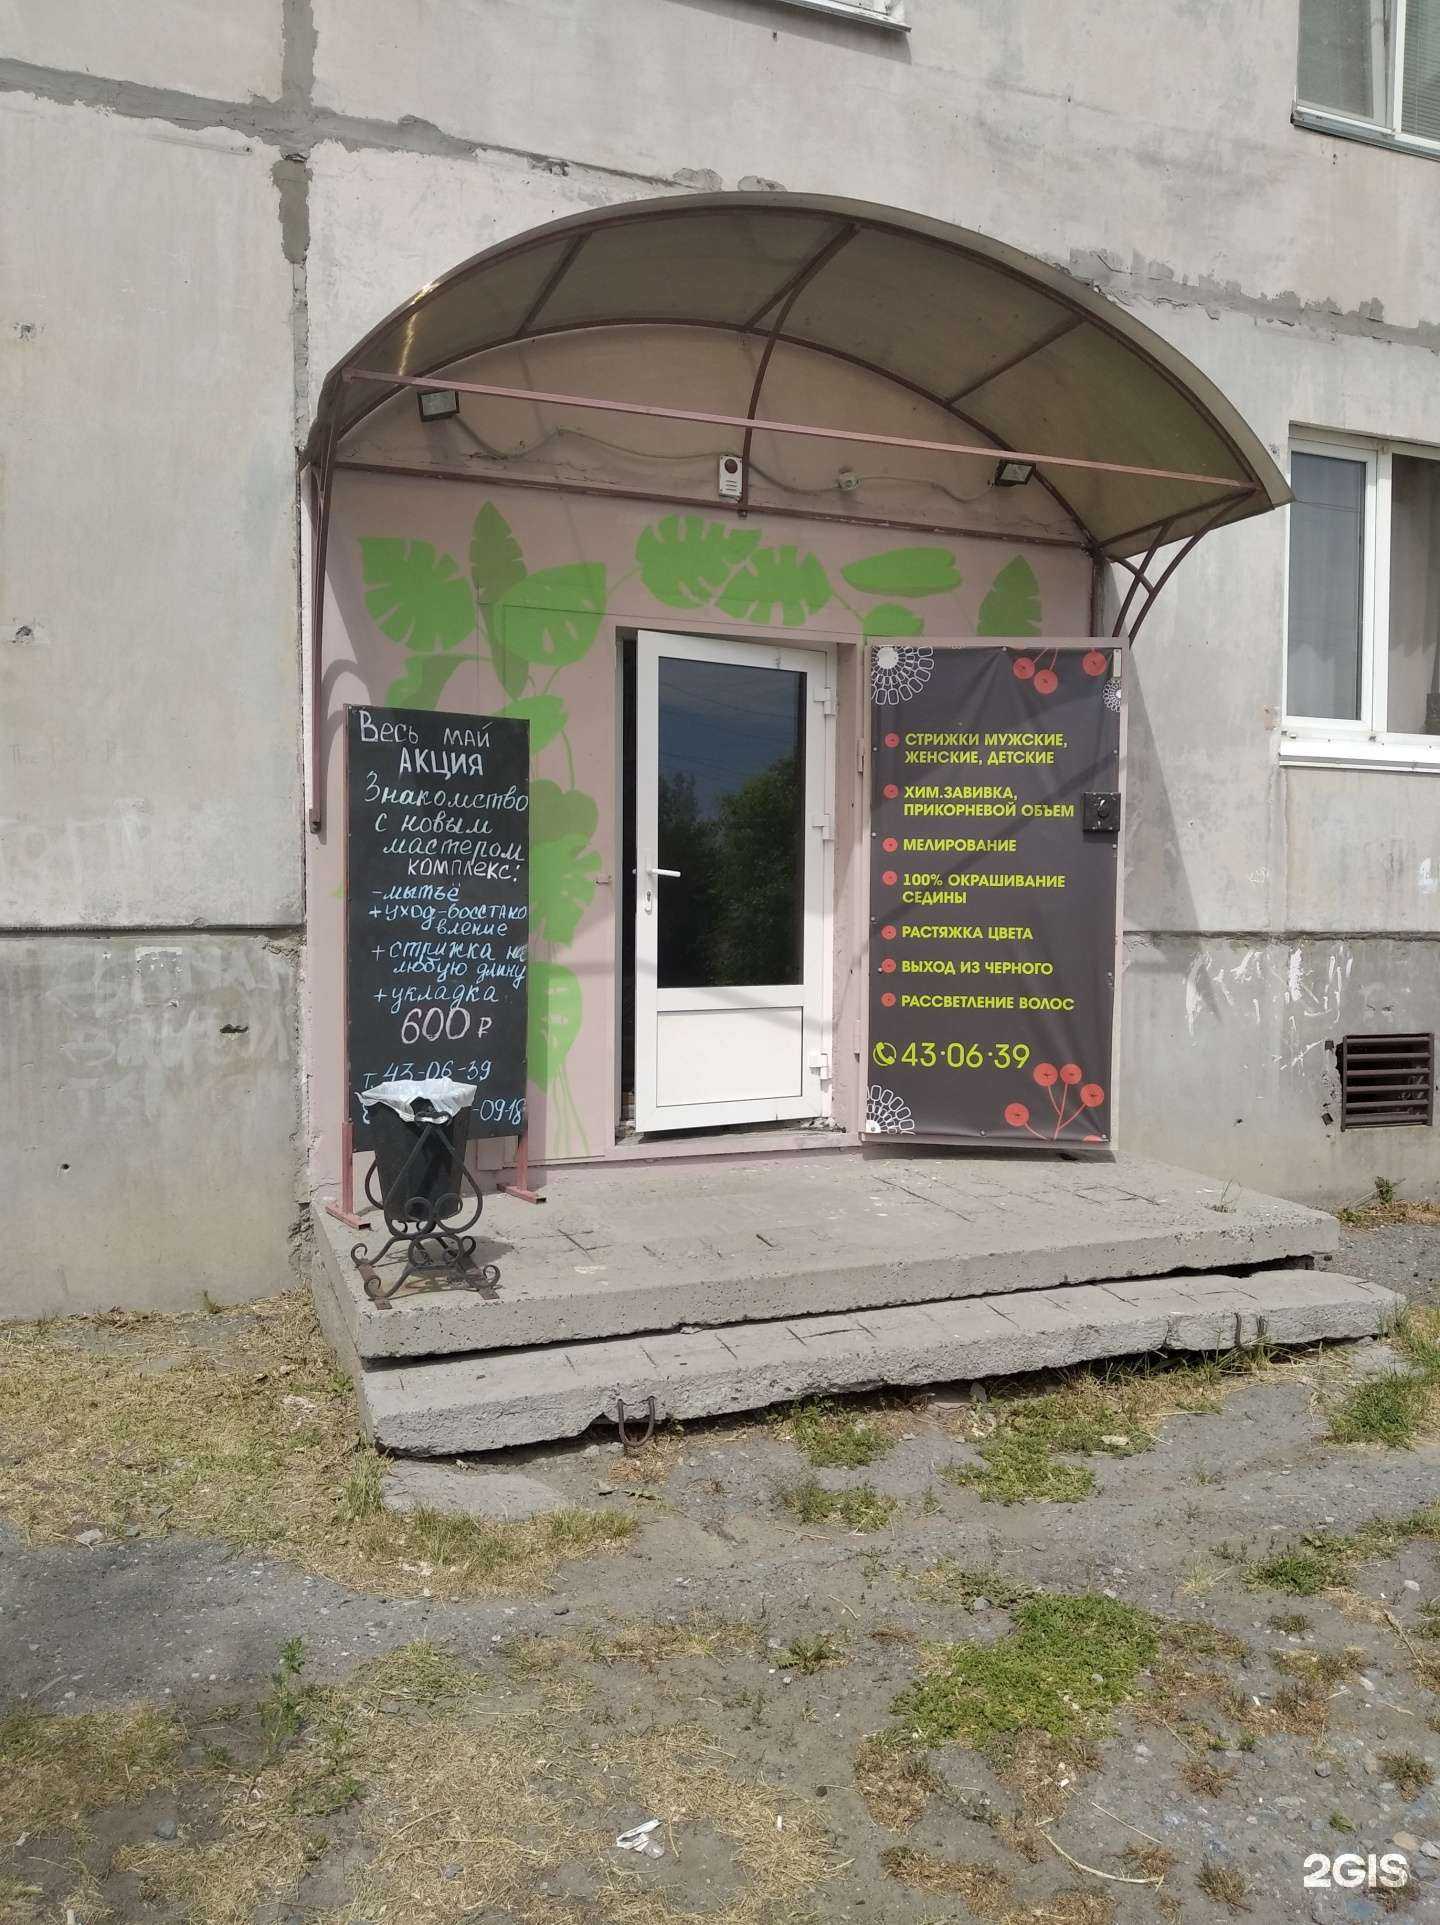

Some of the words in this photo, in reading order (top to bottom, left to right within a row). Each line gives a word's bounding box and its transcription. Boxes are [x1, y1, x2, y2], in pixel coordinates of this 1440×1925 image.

[359, 710, 419, 744] Весь
[905, 733, 980, 746] СТРИЖКИ
[984, 733, 1068, 748] МУЖСКИЕ,
[399, 748, 484, 781] АКЦИЯ
[905, 751, 983, 765] ЖЕНСКИЕ,
[987, 752, 1055, 765] ДЕТСКИЕ
[364, 771, 529, 812] Знакомство
[903, 802, 1017, 817] ПРИКОРНЕВОЙ
[1021, 804, 1075, 817] ОБЪЕМ
[401, 810, 493, 834] новым
[383, 837, 525, 866] мастером
[903, 838, 1017, 852] МЕЛИРОВАНИЕ
[903, 873, 943, 887] 100%
[948, 874, 1066, 888] ОКРАШИВАНИЕ
[902, 891, 967, 905] СЕДИНЫ
[902, 926, 984, 940] РАСТЯЖКА
[988, 927, 1034, 942] ЦВЕТА
[392, 956, 468, 983] любую
[901, 961, 956, 975] ВЫХОД
[960, 961, 980, 974] ИЗ
[985, 962, 1054, 975] ЧЕРНОГО
[901, 995, 1014, 1009] РАССВЕТЛЕНИЕ
[1019, 997, 1075, 1011] ВОЛОС
[401, 1007, 471, 1044] 600
